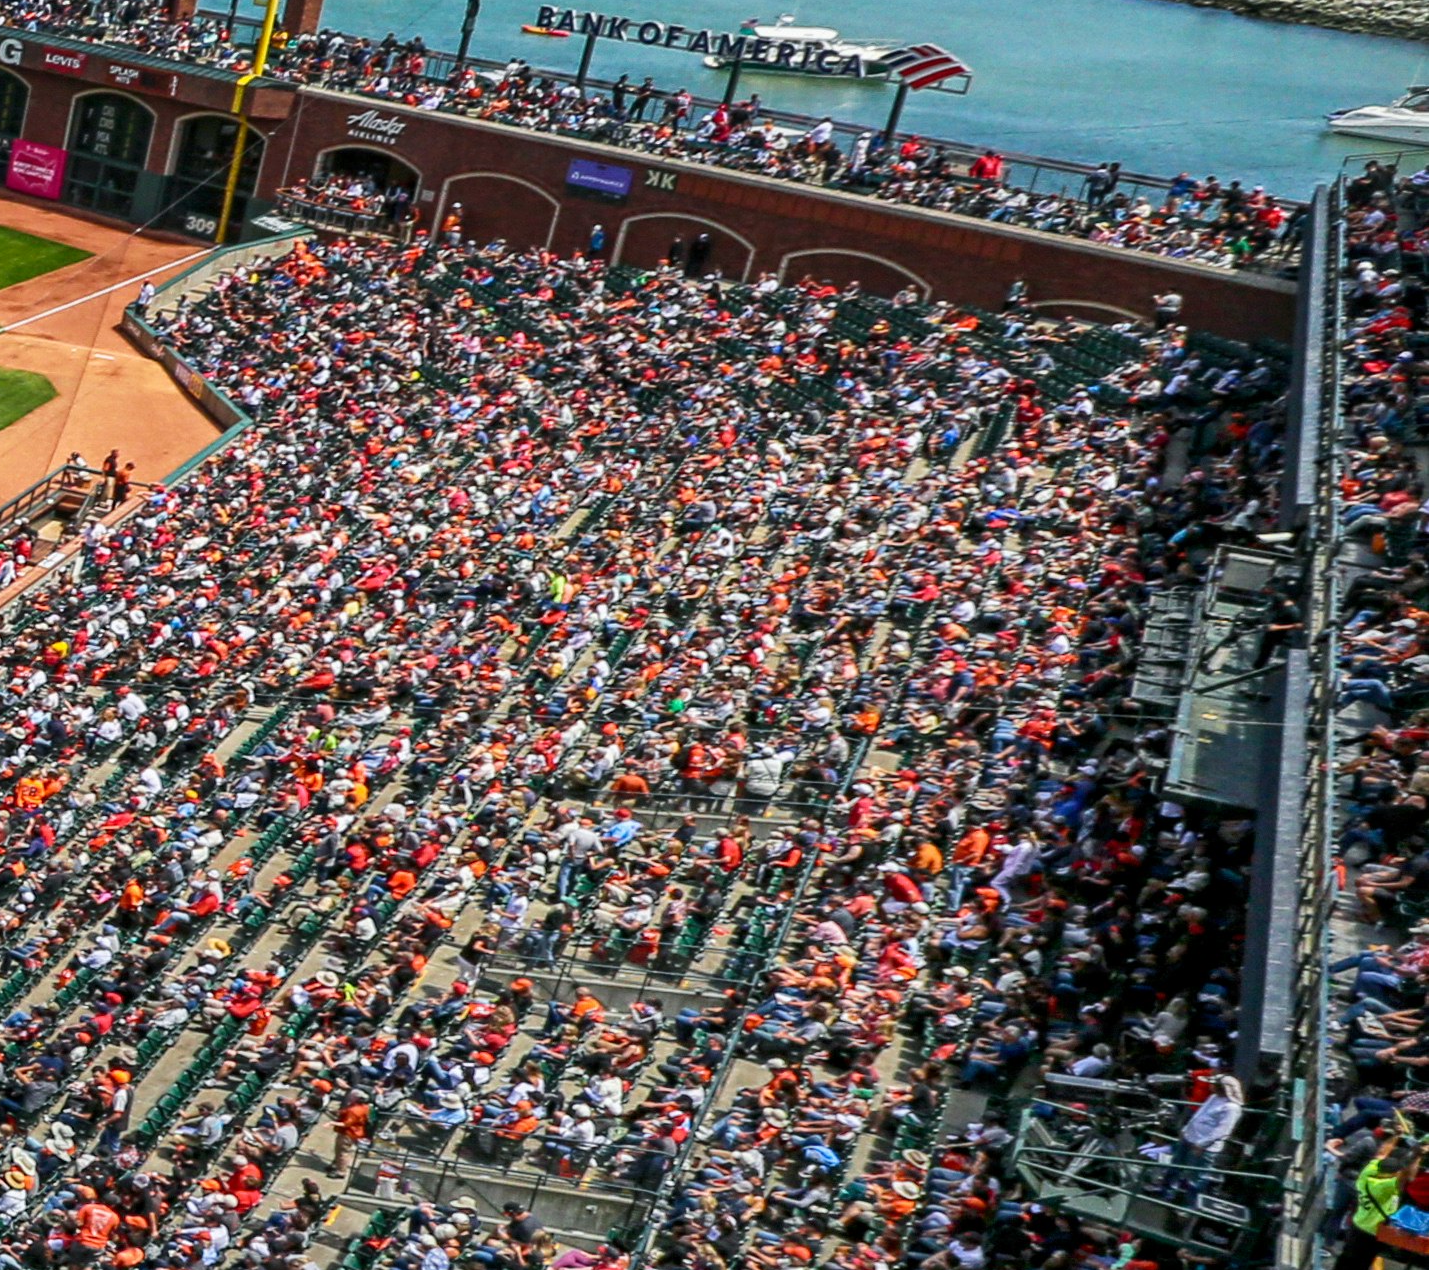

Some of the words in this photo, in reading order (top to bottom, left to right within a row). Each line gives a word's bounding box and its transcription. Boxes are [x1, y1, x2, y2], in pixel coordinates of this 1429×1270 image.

[537, 5, 629, 42] BANK
[639, 21, 684, 48] OF
[691, 30, 864, 78] AMERICA
[109, 65, 139, 79] SPLASH
[347, 109, 406, 135] Alaska
[348, 129, 396, 145] AIRLINES
[186, 216, 217, 235] 309
[21, 785, 38, 797] 28
